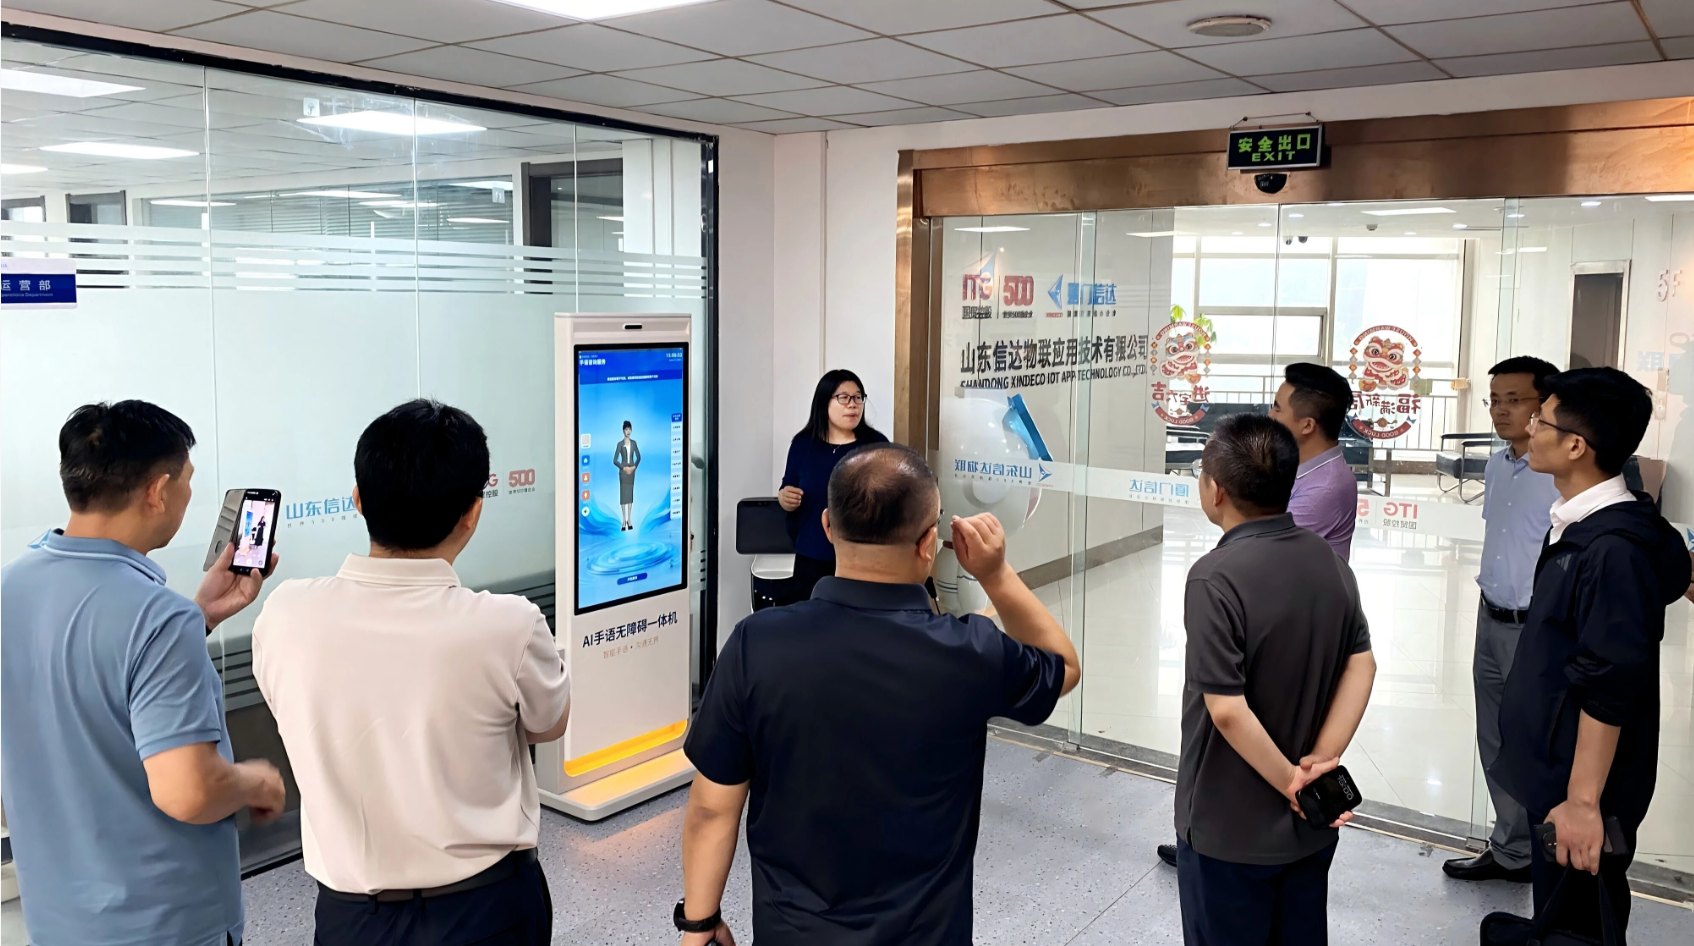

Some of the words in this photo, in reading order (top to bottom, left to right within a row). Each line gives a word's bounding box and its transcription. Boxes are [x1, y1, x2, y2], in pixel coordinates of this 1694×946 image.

[1238, 133, 1311, 153] 安全出口
[1252, 151, 1296, 162] EXIT
[1, 279, 51, 291] 运营部
[1003, 275, 1034, 306] 500
[1657, 269, 1683, 302] 5F
[960, 334, 1149, 375] 山东信达物联应用技术有限公司
[960, 375, 1009, 390] SHANDONG
[1010, 371, 1046, 389] XINDECO
[1047, 370, 1060, 385] IOT
[1078, 365, 1122, 381] TECHNOLOGY
[508, 468, 536, 488] 500
[286, 496, 357, 519] 山东信达
[582, 611, 678, 648] AI手语无障碍一体机
